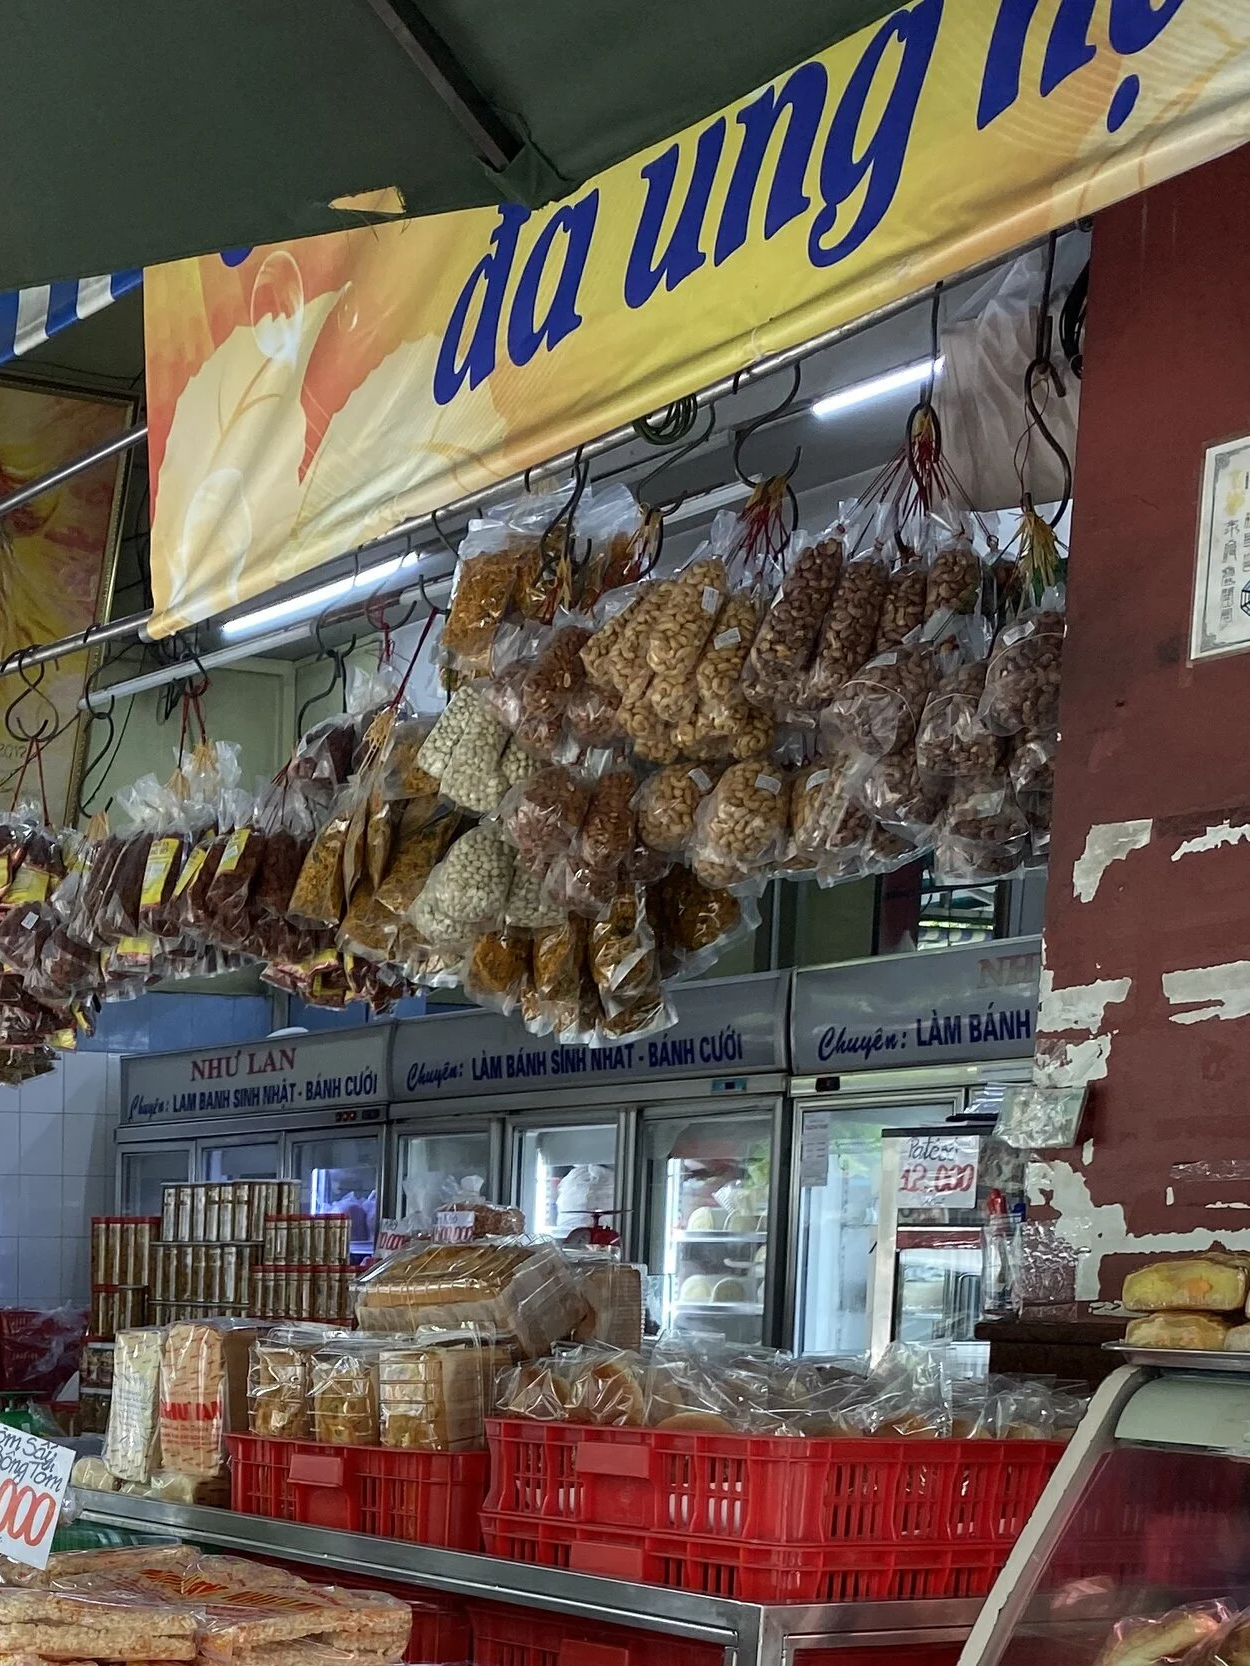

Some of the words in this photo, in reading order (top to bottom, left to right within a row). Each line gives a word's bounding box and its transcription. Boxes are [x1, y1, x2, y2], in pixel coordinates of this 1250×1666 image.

[916, 1009, 962, 1047] LÀM
[969, 1002, 1031, 1043] BÁNH
[190, 1050, 241, 1082] NHƯ
[246, 1047, 298, 1075] LAN
[472, 1049, 502, 1081] LÀM
[506, 1047, 547, 1078] BÁNH
[649, 1032, 695, 1069] BÁNH
[700, 1026, 743, 1061] CƯỚI
[233, 1085, 260, 1109] SINH
[305, 1072, 342, 1102] BÁNH
[345, 1065, 378, 1097] CƯỚI
